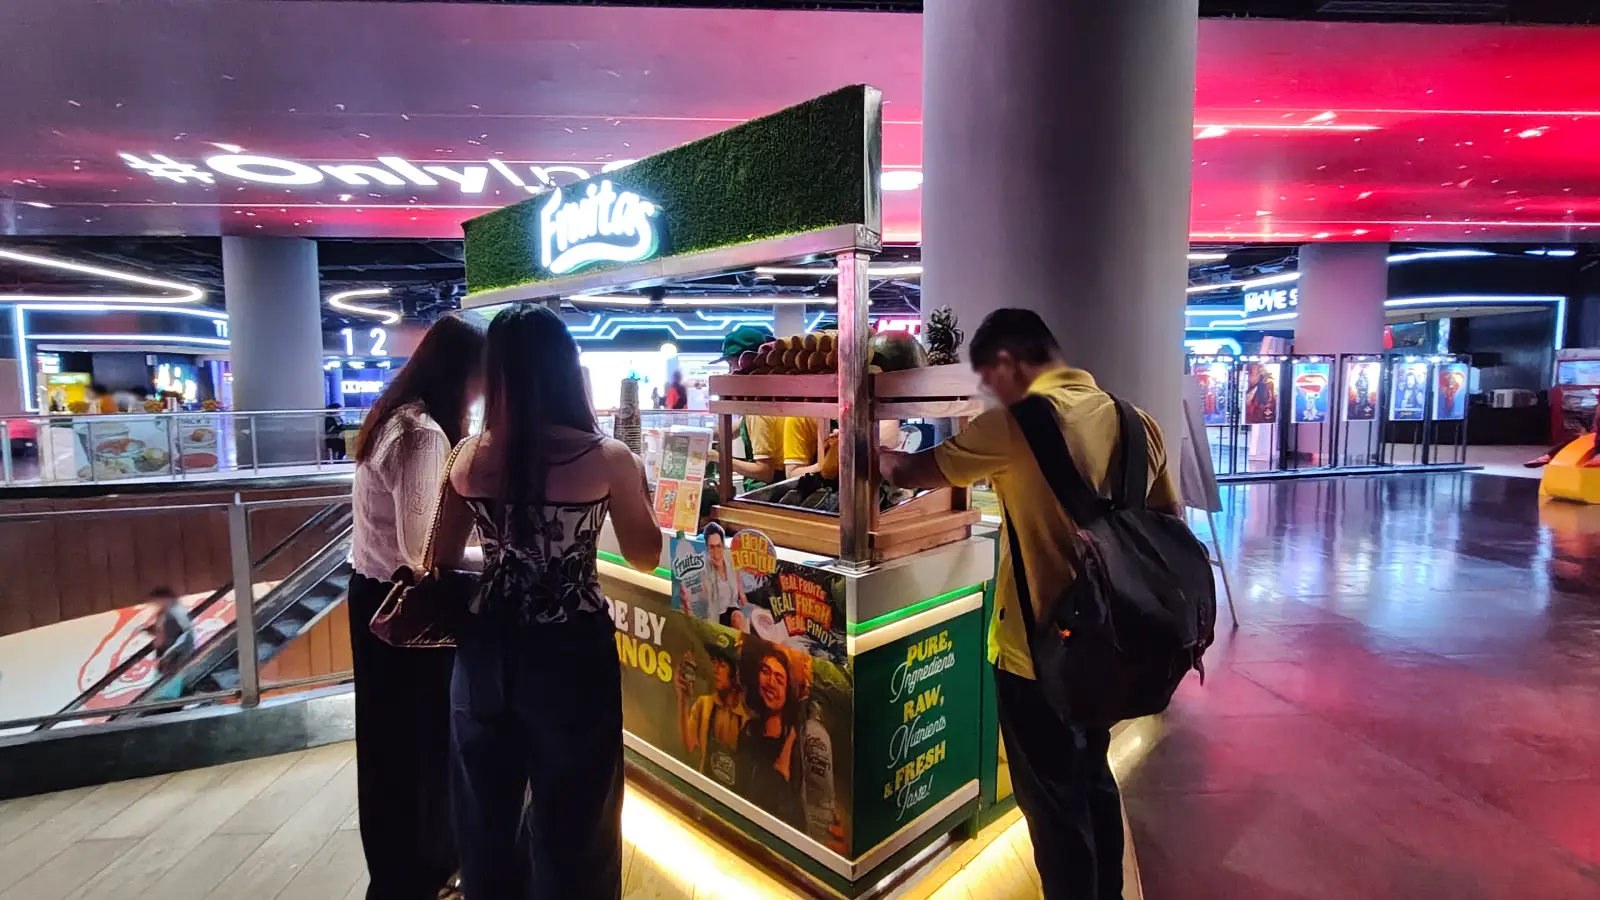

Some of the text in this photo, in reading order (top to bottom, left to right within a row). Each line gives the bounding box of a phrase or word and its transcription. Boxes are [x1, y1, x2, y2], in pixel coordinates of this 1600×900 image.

[541, 180, 656, 274] Fruitas
[674, 553, 705, 577] Fruitas
[634, 606, 666, 646] BY
[771, 592, 831, 622] REAL FRESH
[807, 618, 836, 647] PINOY
[907, 630, 952, 667] PURE,
[889, 652, 955, 703] Ingredients
[903, 684, 944, 723] RAW,
[887, 715, 946, 768] Nutrients
[895, 740, 946, 791] FRESH
[896, 773, 933, 821] Taste!
